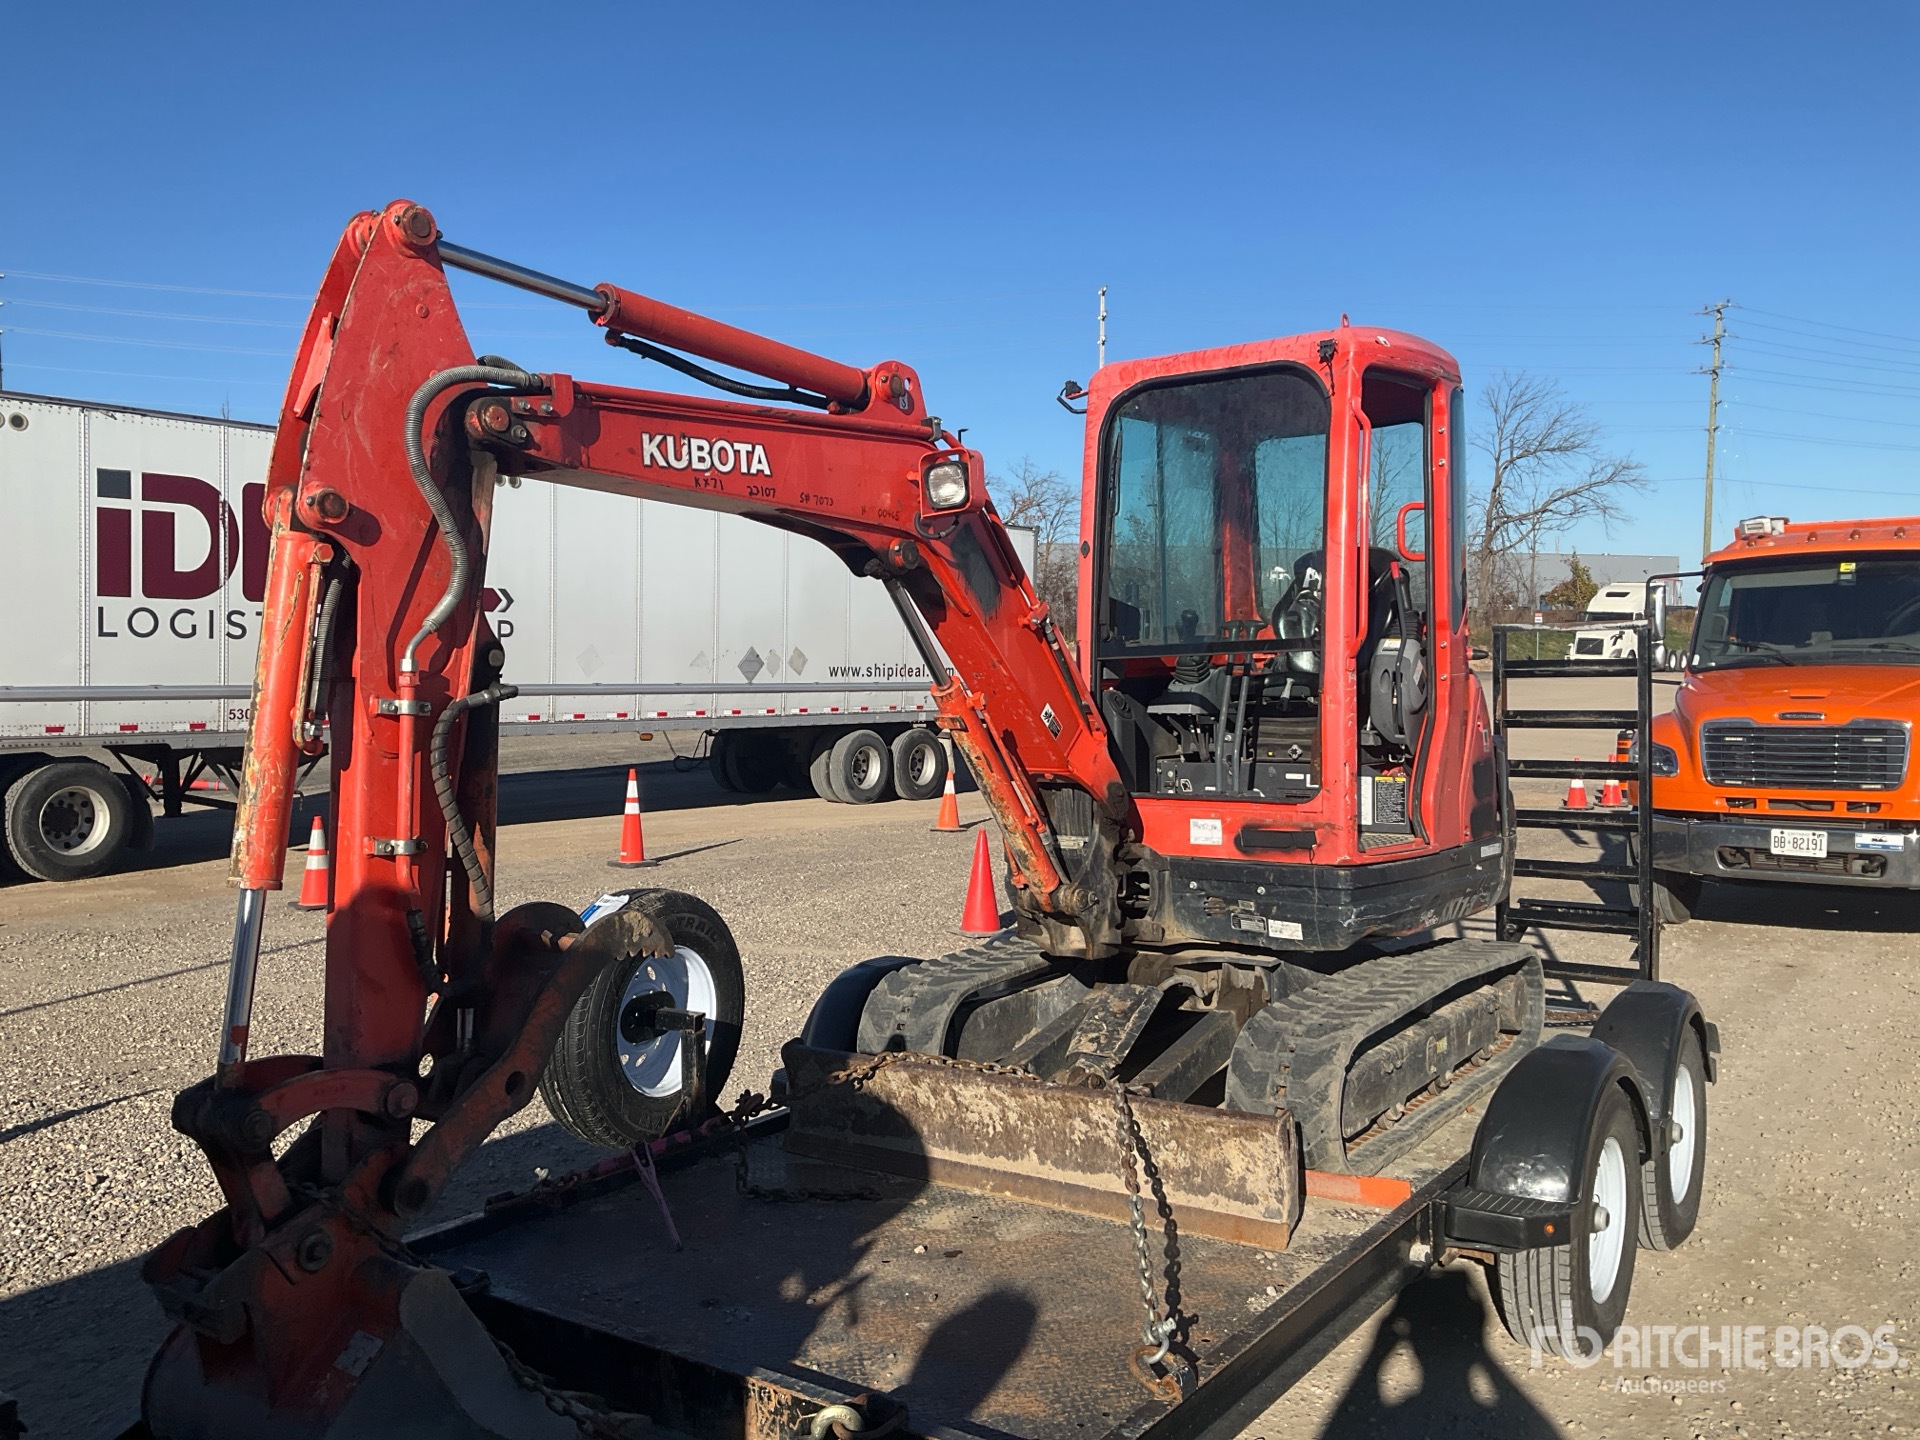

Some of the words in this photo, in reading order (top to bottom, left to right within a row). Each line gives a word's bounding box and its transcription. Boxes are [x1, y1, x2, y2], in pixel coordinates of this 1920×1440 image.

[641, 432, 772, 476] KUBOTA
[98, 606, 263, 640] LOGIS
[1792, 837, 1823, 851] 82191
